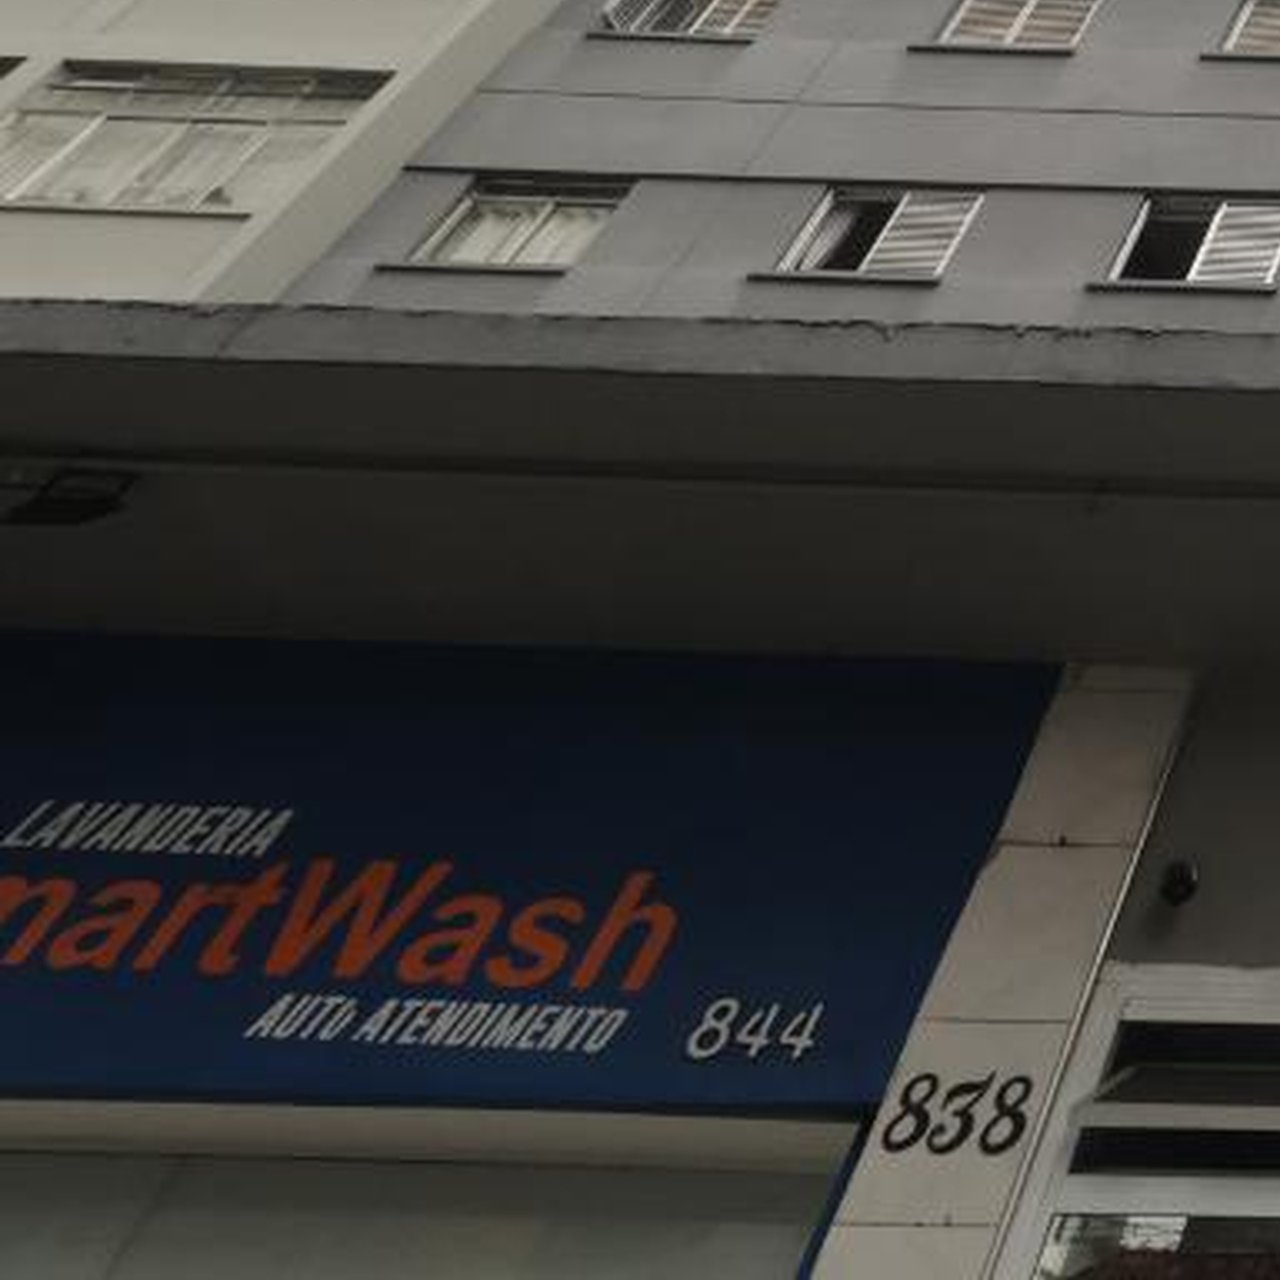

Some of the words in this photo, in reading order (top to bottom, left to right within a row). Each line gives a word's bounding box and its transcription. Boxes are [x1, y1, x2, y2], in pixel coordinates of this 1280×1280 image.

[2, 799, 293, 856] LAVANDERIA
[245, 993, 359, 1040] AUTO
[352, 999, 628, 1053] ATENDIMENTO
[687, 998, 824, 1059] 844
[883, 1070, 1033, 1154] 838
